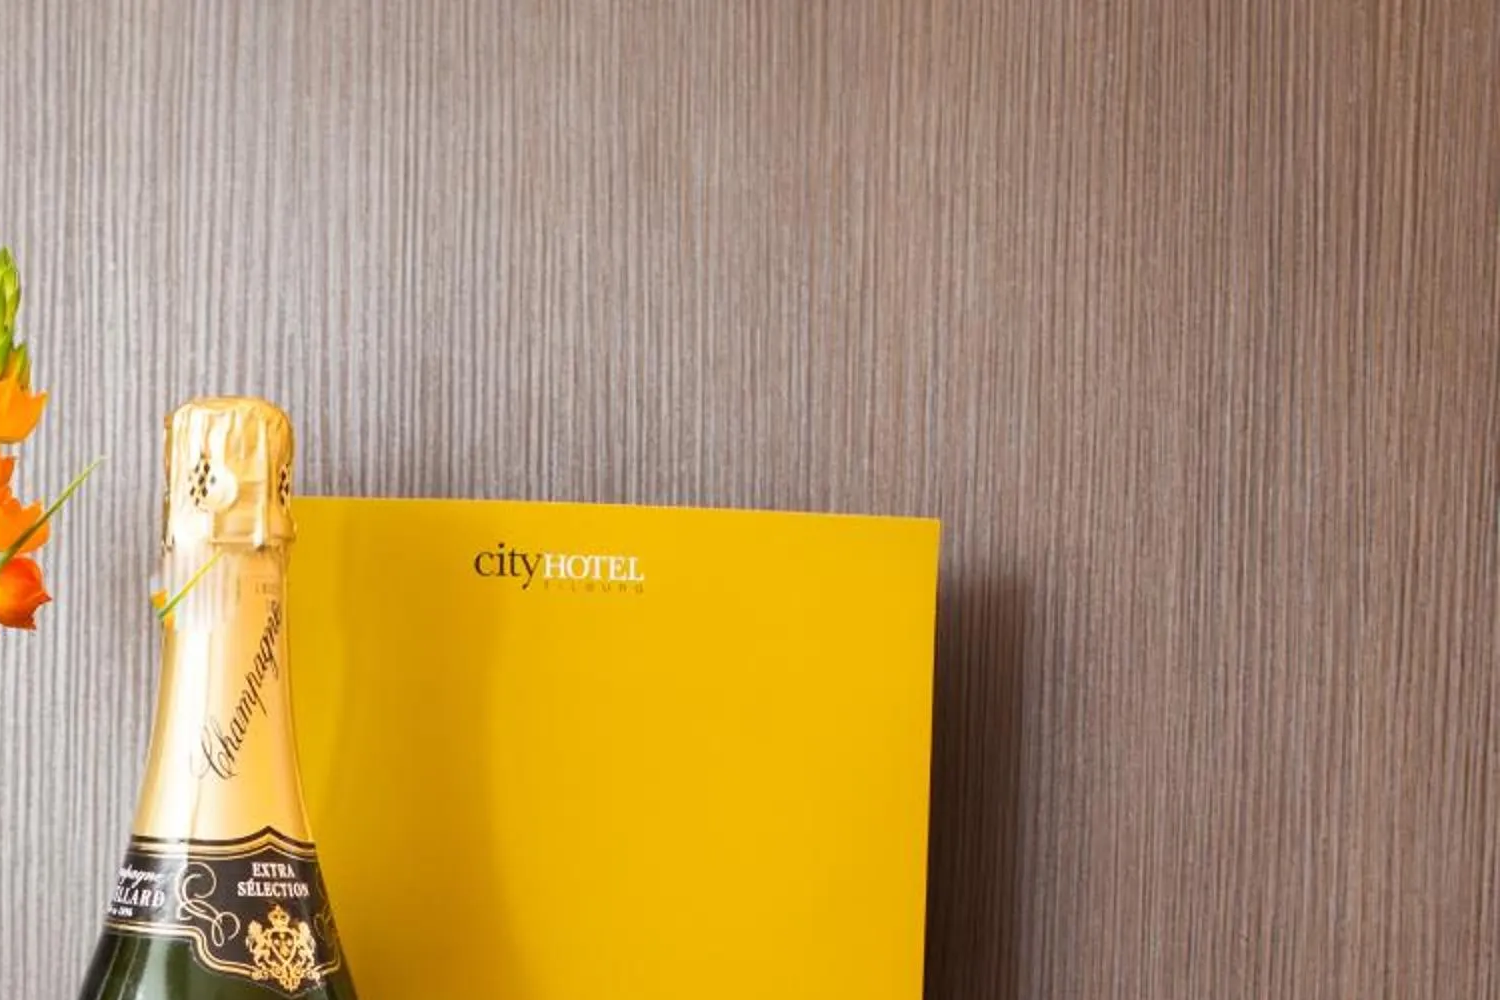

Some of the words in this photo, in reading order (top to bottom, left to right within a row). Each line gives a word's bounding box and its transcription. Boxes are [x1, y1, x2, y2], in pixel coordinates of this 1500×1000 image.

[190, 599, 283, 780] Champagne
[251, 861, 296, 878] EXTRA
[237, 878, 310, 897] SÉLECTION
